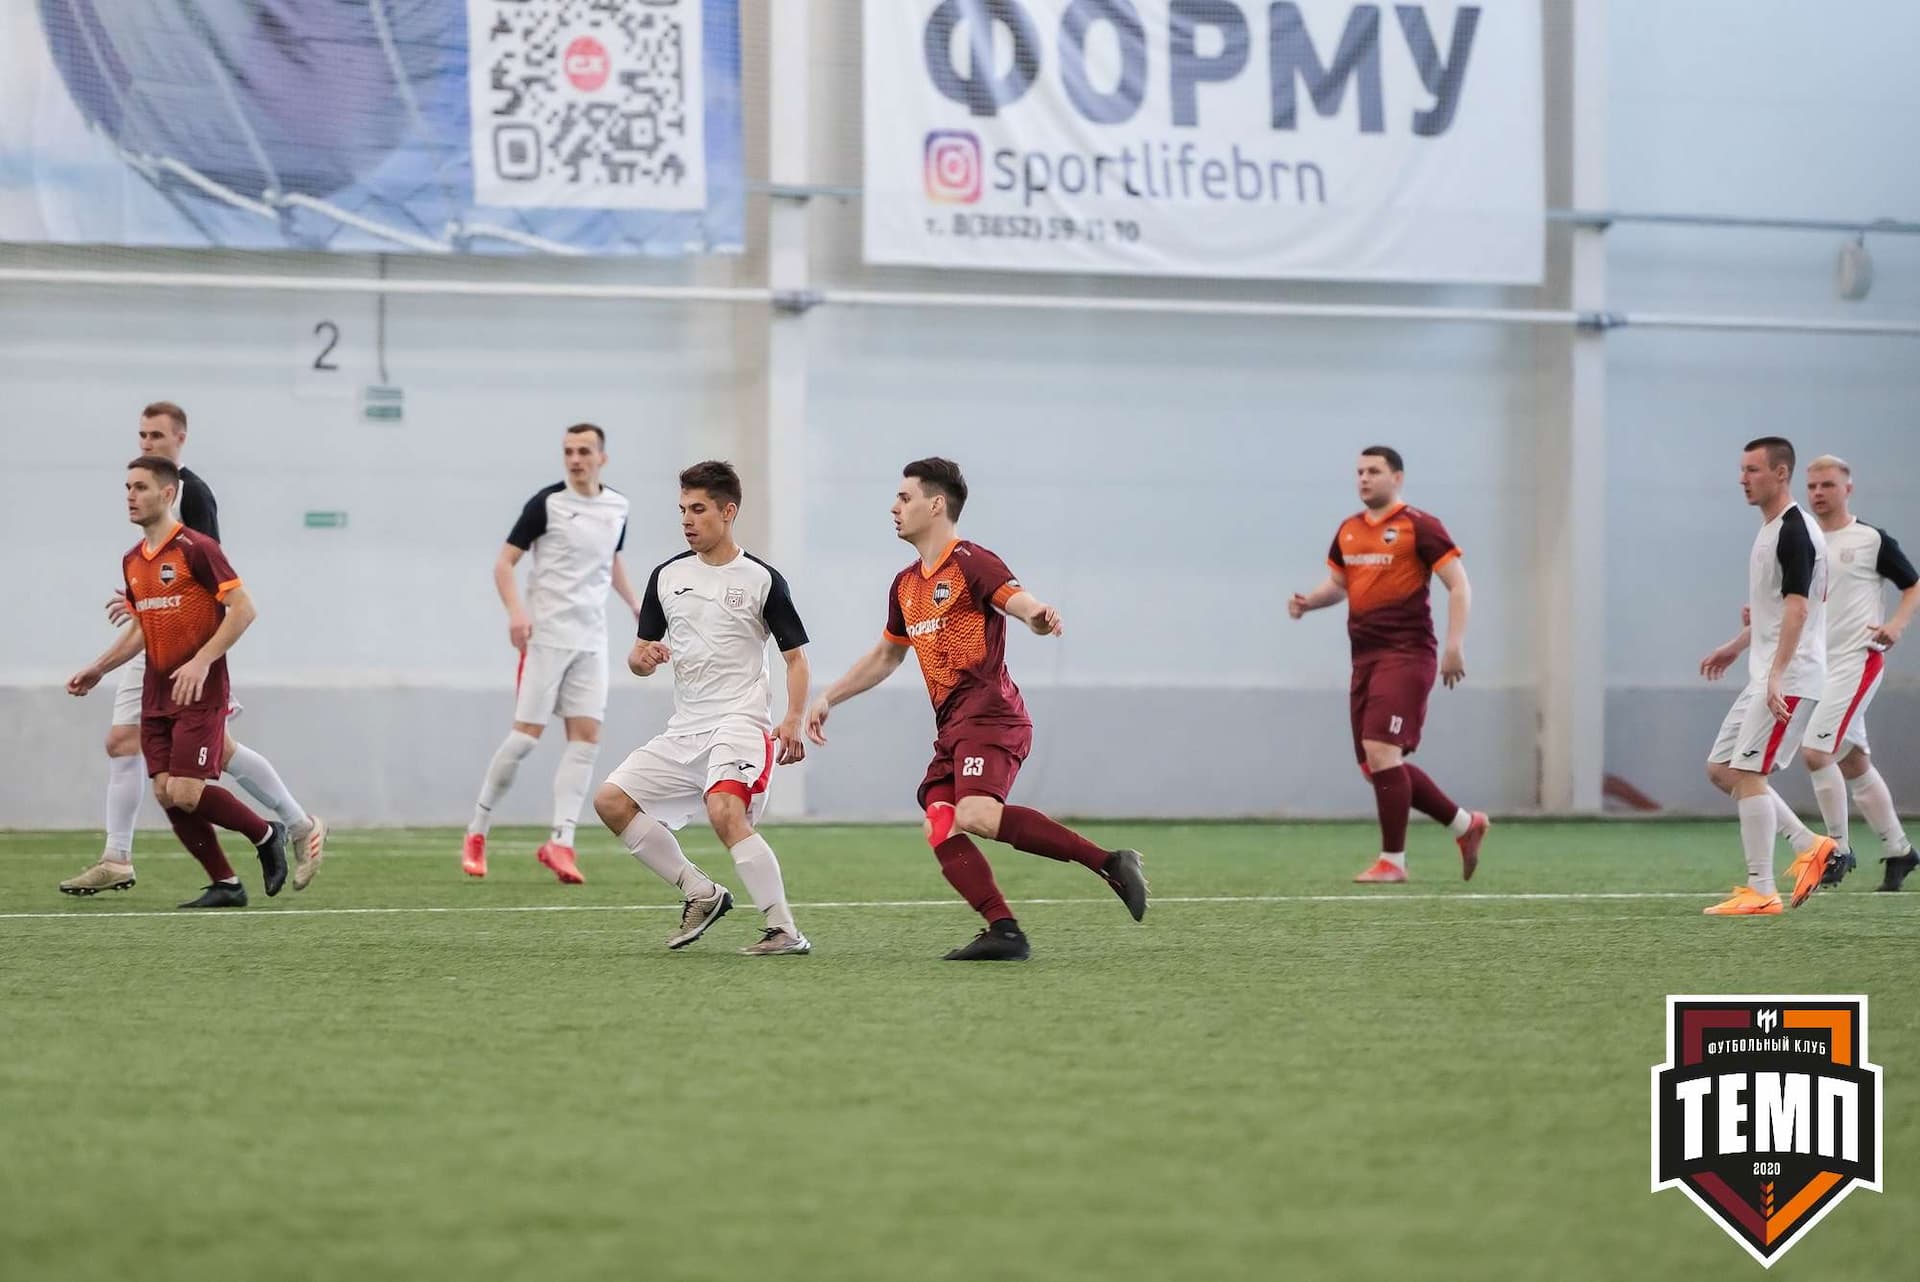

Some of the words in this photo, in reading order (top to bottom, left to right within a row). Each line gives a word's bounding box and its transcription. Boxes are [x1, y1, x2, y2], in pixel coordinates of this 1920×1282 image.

[923, 0, 1482, 137] ФОРМУ
[993, 141, 1327, 207] sportlifebrn
[312, 320, 340, 370] 2
[962, 756, 985, 776] 23
